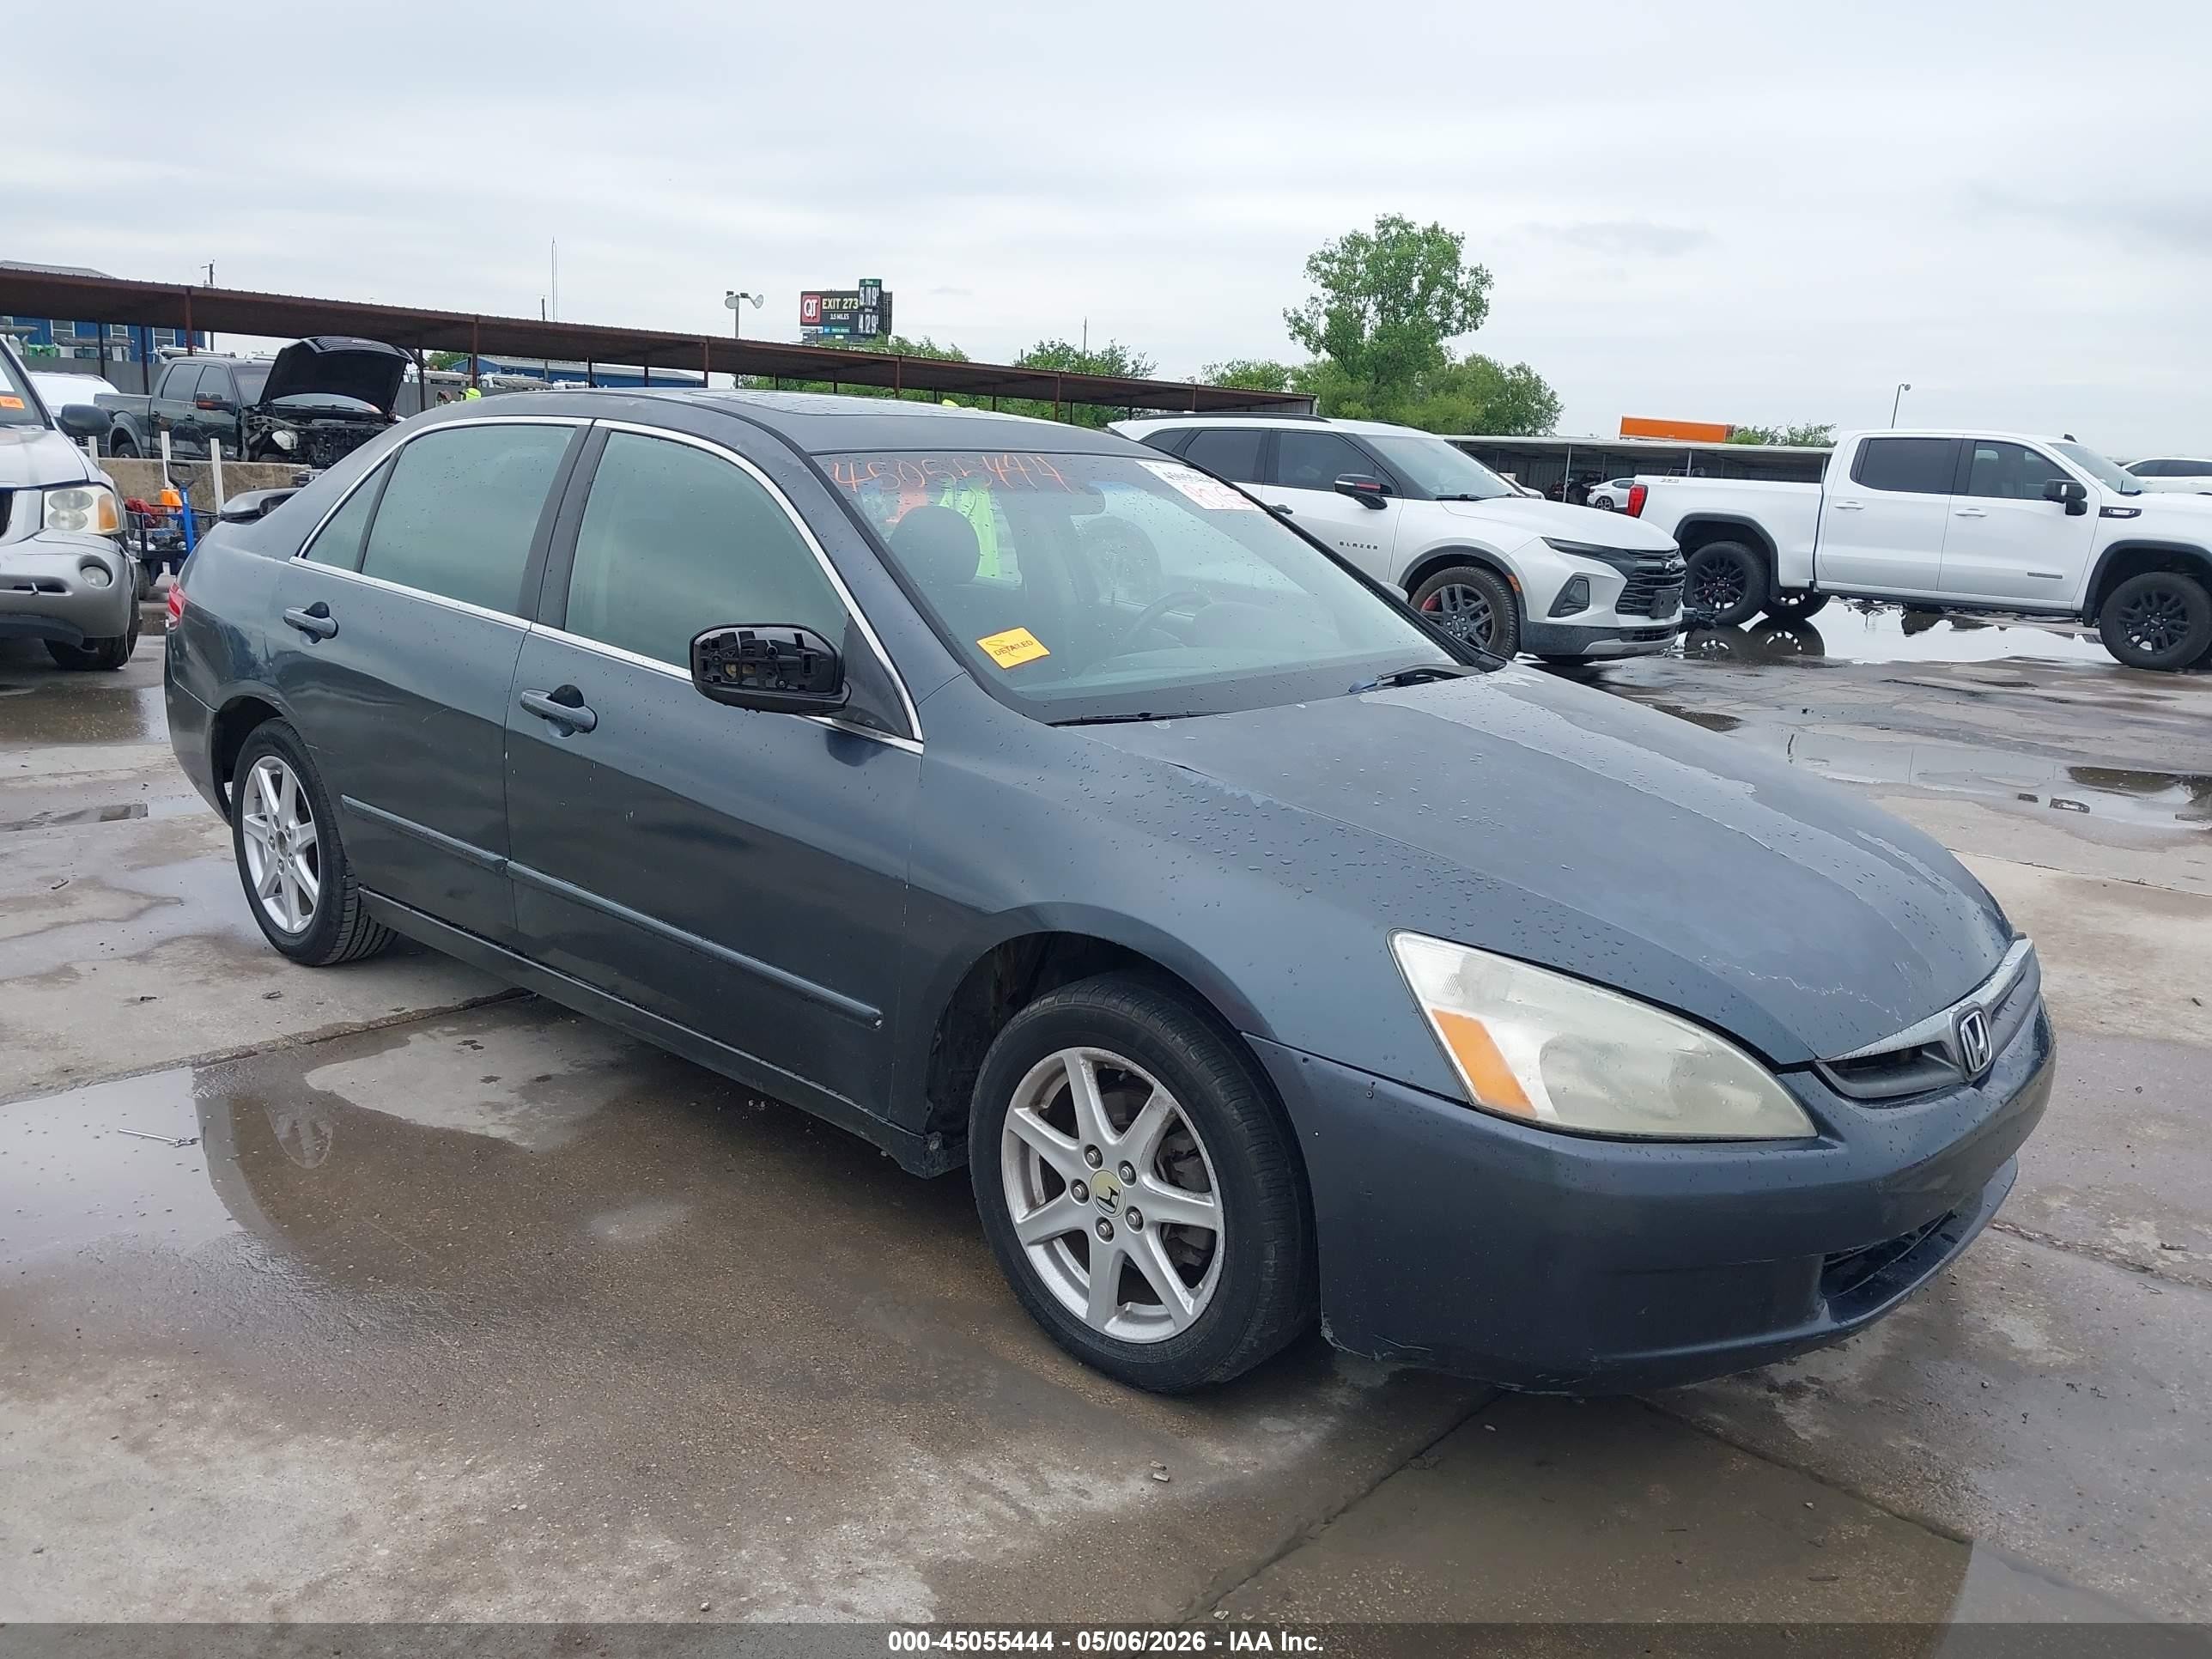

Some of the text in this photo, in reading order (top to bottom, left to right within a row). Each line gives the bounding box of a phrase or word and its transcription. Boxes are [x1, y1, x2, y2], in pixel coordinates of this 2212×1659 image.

[804, 298, 817, 318] QT
[822, 297, 859, 309] EXIT 273
[834, 454, 1073, 494] 45055444
[1340, 541, 1378, 550] BLAZER
[994, 639, 1035, 656] DETAILED
